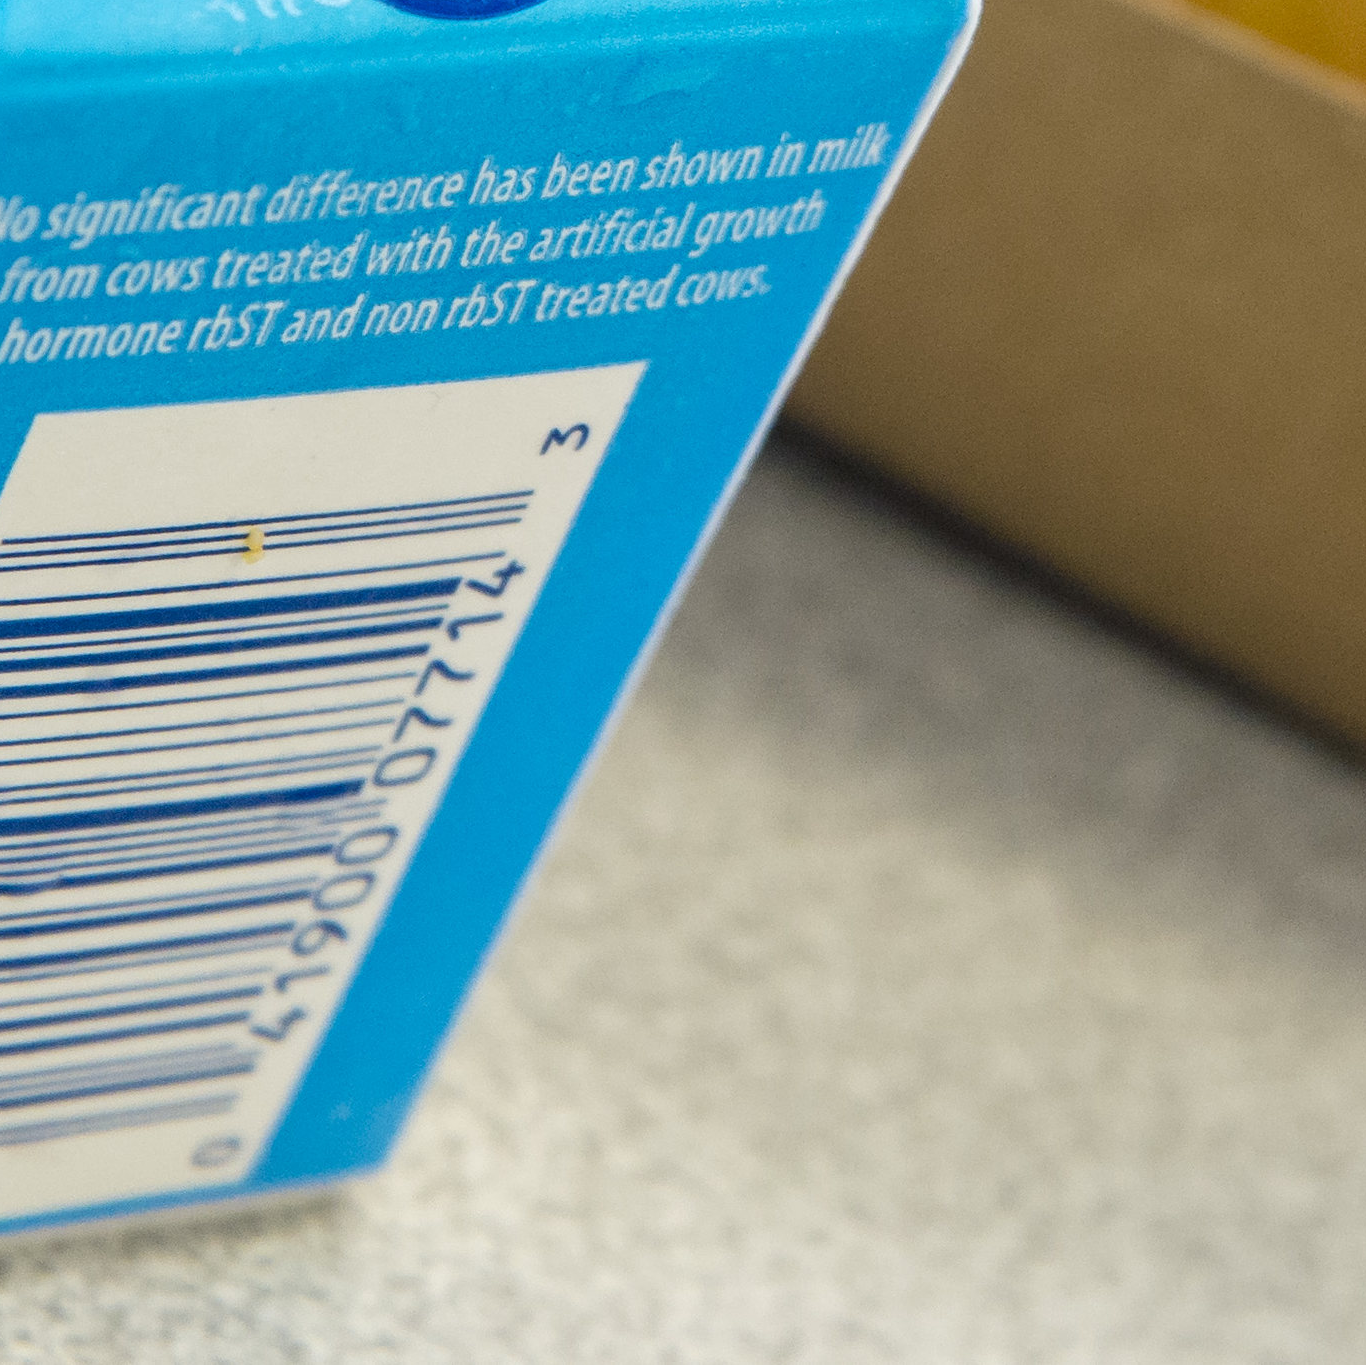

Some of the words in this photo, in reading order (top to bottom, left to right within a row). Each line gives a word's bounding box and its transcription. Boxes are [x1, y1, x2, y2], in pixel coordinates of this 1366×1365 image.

[40, 183, 267, 251] significant
[265, 169, 467, 225] difference
[469, 154, 536, 206] has
[540, 151, 638, 200] been
[639, 140, 765, 192] shown
[765, 131, 809, 180] in
[807, 121, 892, 175] milk
[105, 255, 209, 299] cows
[212, 230, 370, 291] treated
[365, 224, 455, 277] with
[459, 218, 528, 269] the
[528, 201, 697, 263] artificial
[689, 189, 829, 260] growth
[185, 299, 289, 354] rbST
[280, 291, 371, 346] and
[361, 297, 441, 337] non
[442, 278, 537, 331] rbST
[534, 263, 682, 324] treated
[675, 263, 773, 310] cows.
[192, 1133, 244, 1174] 0
[249, 824, 401, 1046] 41900
[372, 557, 528, 790] 07714
[539, 421, 592, 457] 3
